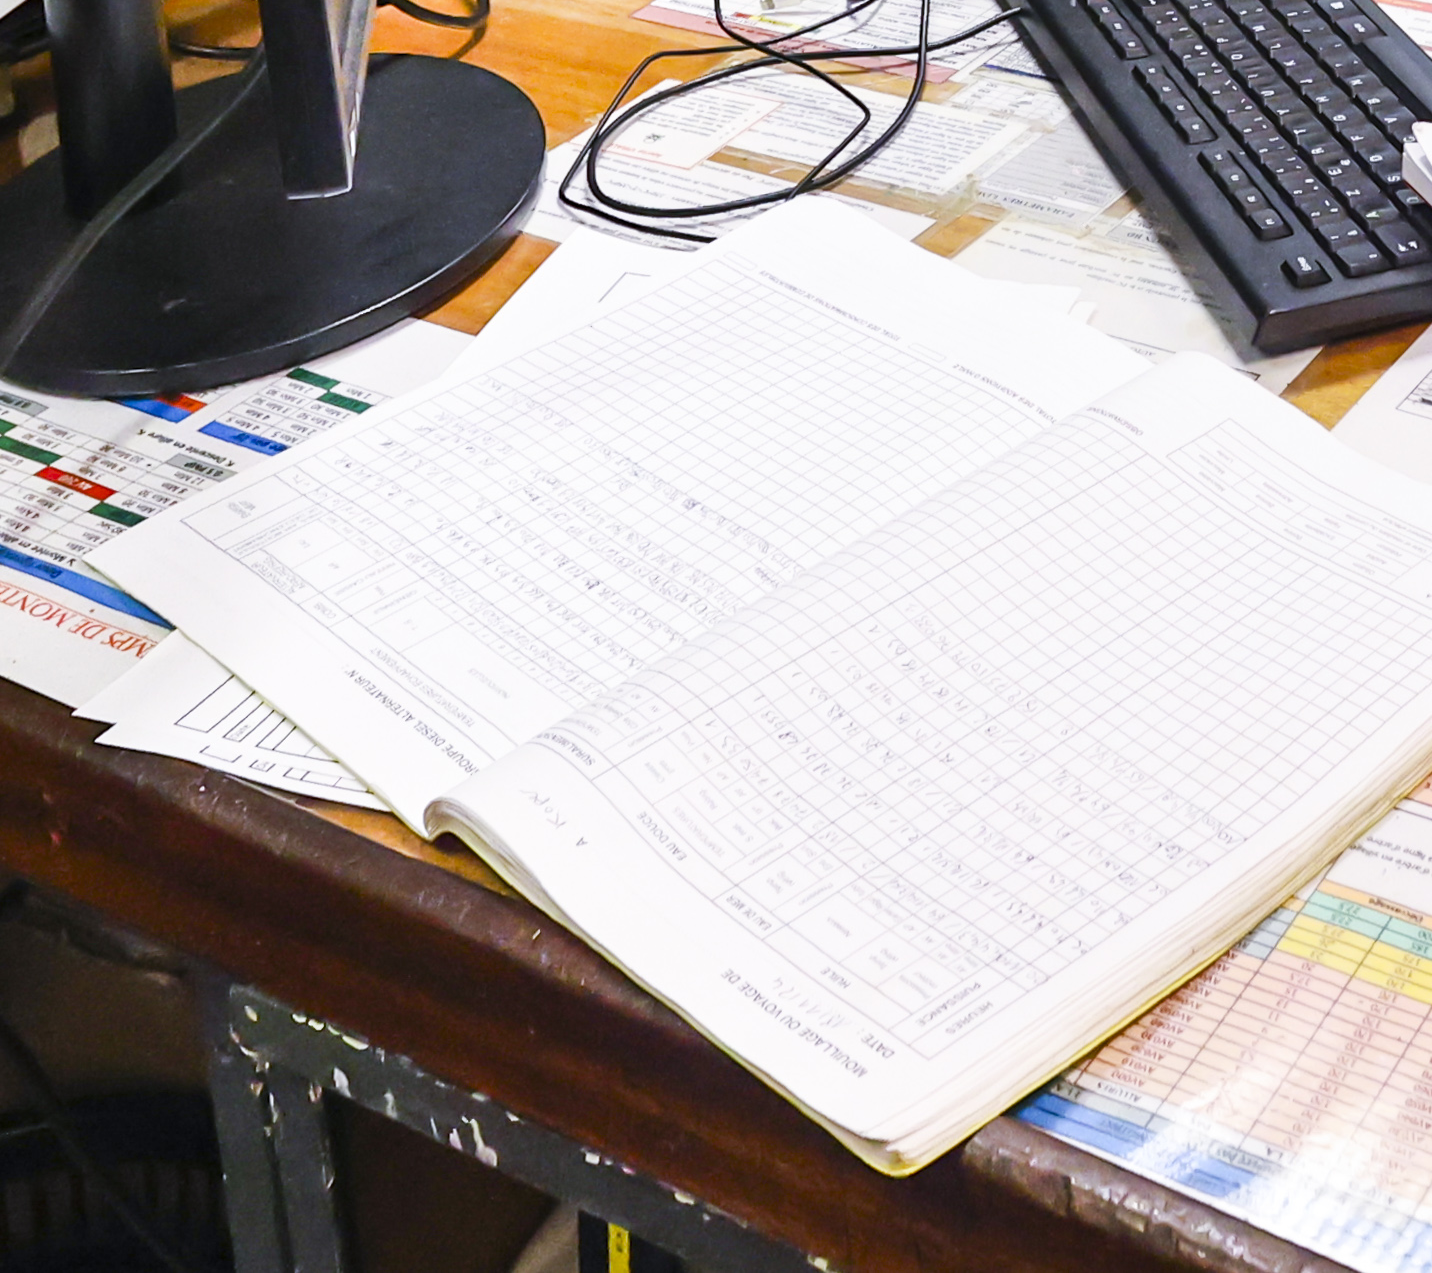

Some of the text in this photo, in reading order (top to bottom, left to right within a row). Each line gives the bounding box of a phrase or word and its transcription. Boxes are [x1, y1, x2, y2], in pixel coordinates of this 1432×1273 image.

[70, 613, 106, 642] DE
[354, 673, 415, 725] ALTERNATEUR
[411, 717, 446, 749] DIESEL
[1401, 842, 1429, 861] ligne
